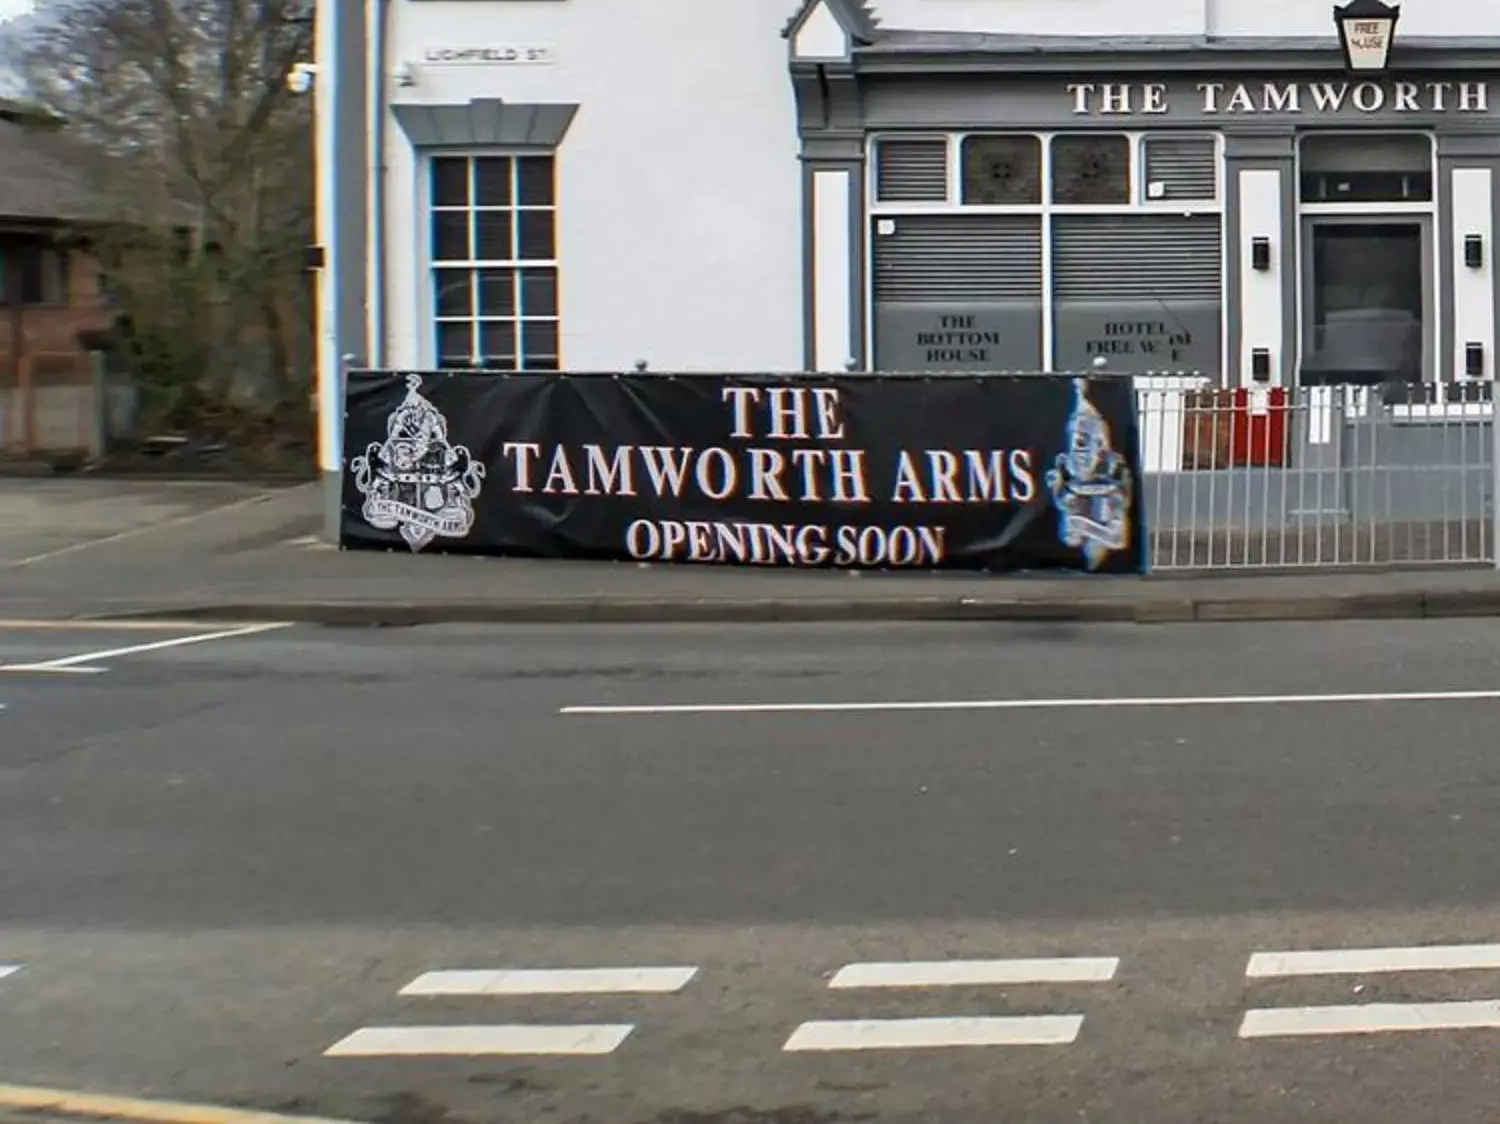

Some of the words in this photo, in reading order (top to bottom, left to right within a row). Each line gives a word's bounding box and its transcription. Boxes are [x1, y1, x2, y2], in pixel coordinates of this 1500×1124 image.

[1066, 82, 1169, 114] THE
[1196, 82, 1490, 113] TAMWORTH
[938, 314, 977, 328] THE
[1104, 322, 1169, 335] HOTEL
[916, 331, 1001, 346] BOTTOM
[926, 349, 992, 362] HOUSE
[722, 387, 845, 440] THE
[502, 442, 870, 502] TAMWORTH
[891, 449, 1036, 503] ARMS
[626, 518, 830, 566] OPENING
[834, 524, 946, 564] SOON
